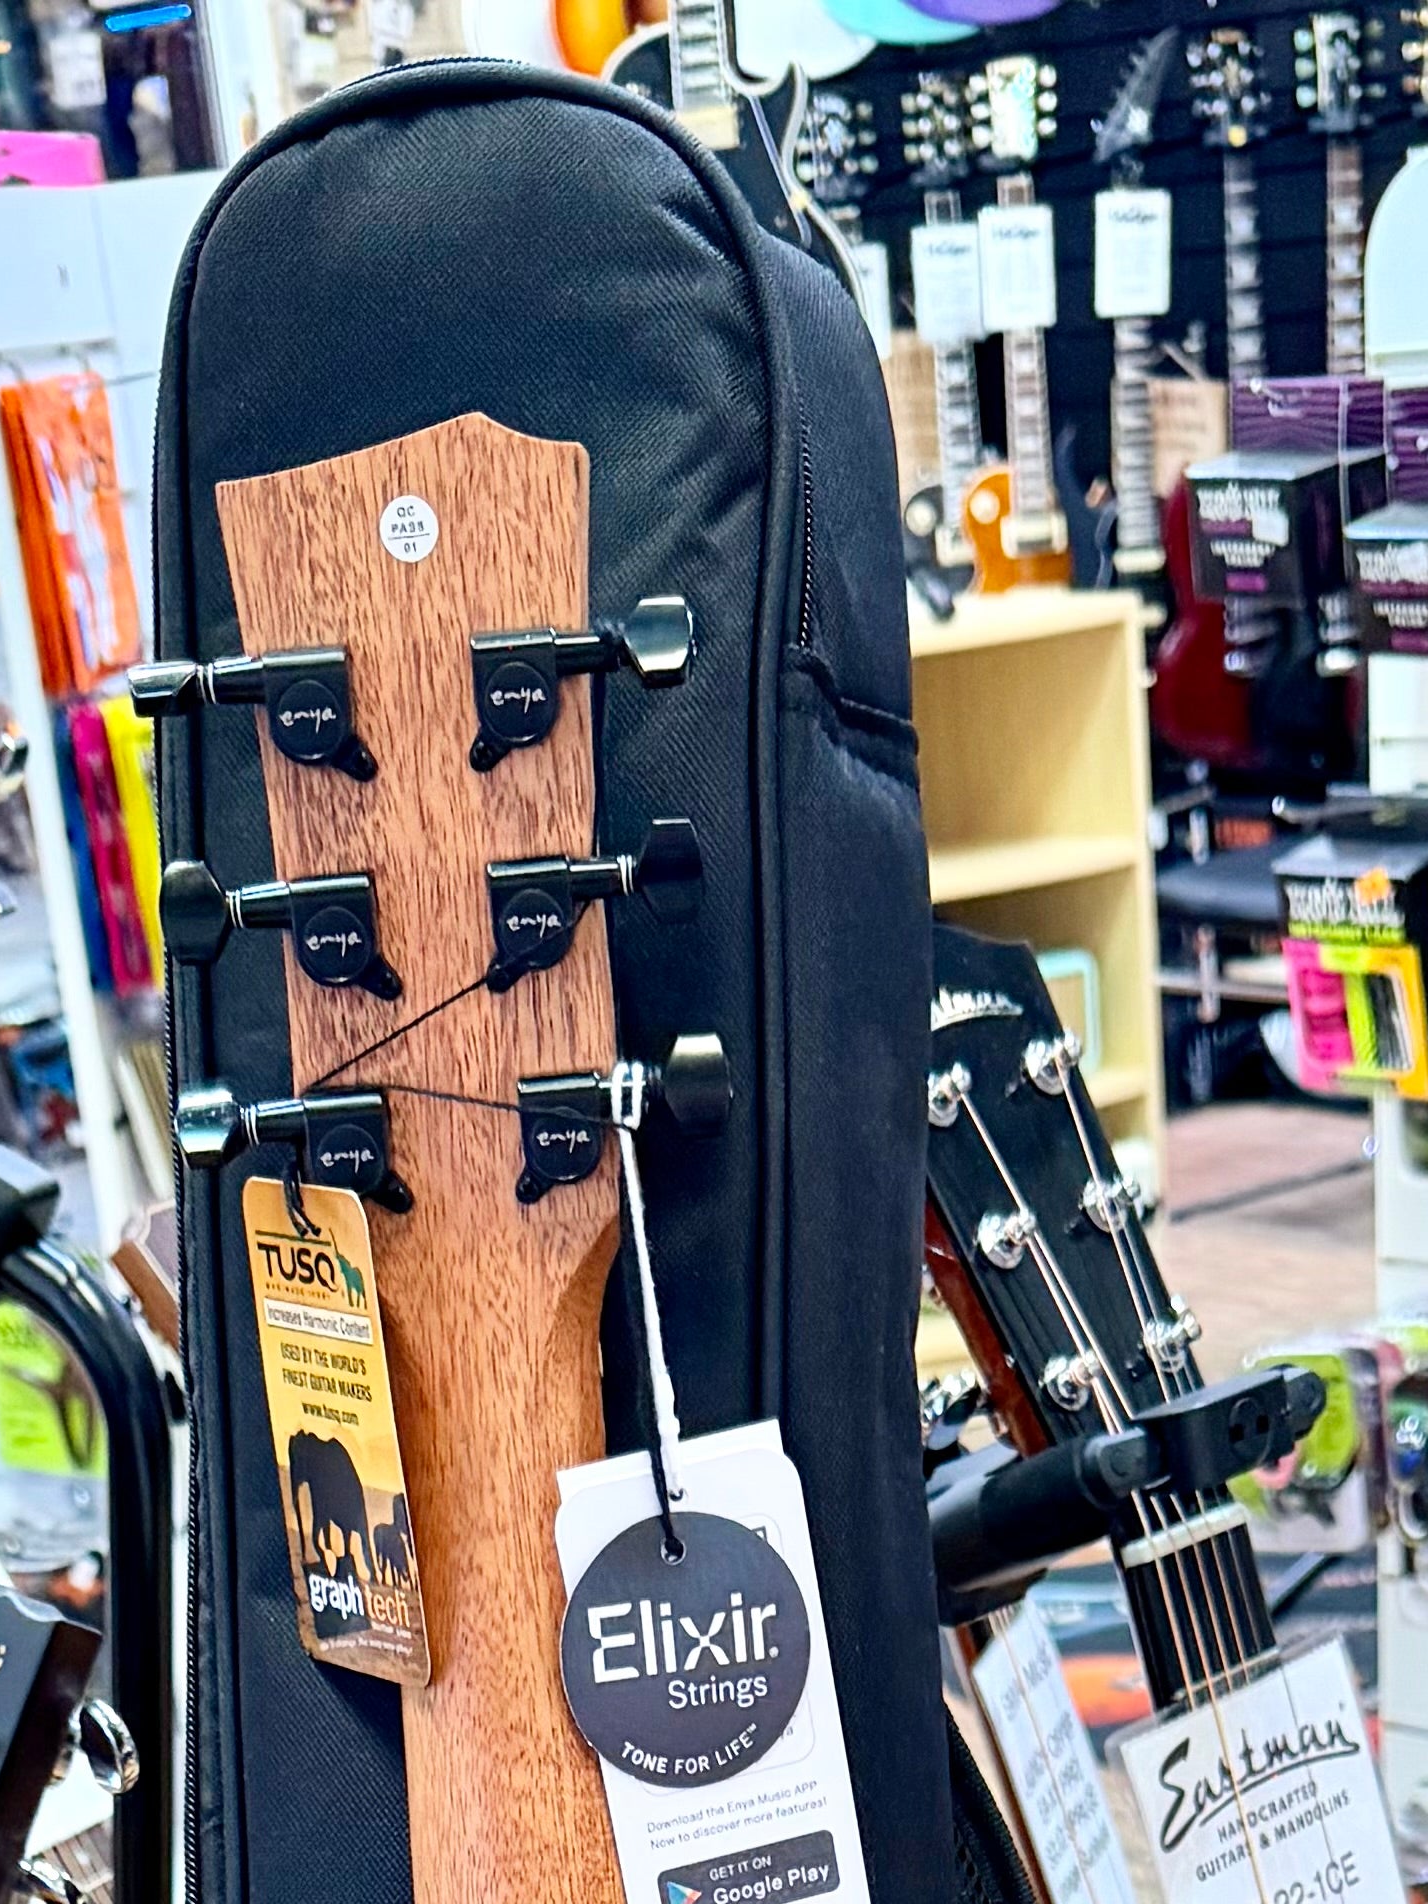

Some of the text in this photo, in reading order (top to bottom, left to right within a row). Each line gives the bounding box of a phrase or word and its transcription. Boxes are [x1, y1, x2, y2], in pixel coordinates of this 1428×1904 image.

[397, 505, 415, 518] QC
[404, 542, 417, 553] 01
[490, 687, 546, 714] enya
[280, 707, 337, 733] enya
[506, 913, 561, 938] enya
[306, 931, 362, 957] enya
[536, 1130, 591, 1154] enya
[320, 1149, 374, 1173] enya
[257, 1241, 339, 1293] TUSQ
[303, 1310, 339, 1333] Harmonic
[340, 1317, 370, 1339] Content
[280, 1342, 367, 1376] USED BY THE WORLD'S
[282, 1367, 373, 1402] FINEST GUITAR MAKERS
[668, 1674, 769, 1710] Strings
[621, 1741, 669, 1775] TONE
[674, 1754, 710, 1775] FOR
[1158, 1719, 1361, 1854] Eastman
[647, 1780, 818, 1834] Download the Enya Music APP
[1217, 1779, 1317, 1843] HANDCRAFTED
[1259, 1832, 1271, 1850] &
[1274, 1788, 1351, 1843] MANDOLINS
[650, 1796, 828, 1851] Now to discover more features!
[709, 1855, 772, 1882] GET IT ON
[786, 1863, 830, 1888] Play
